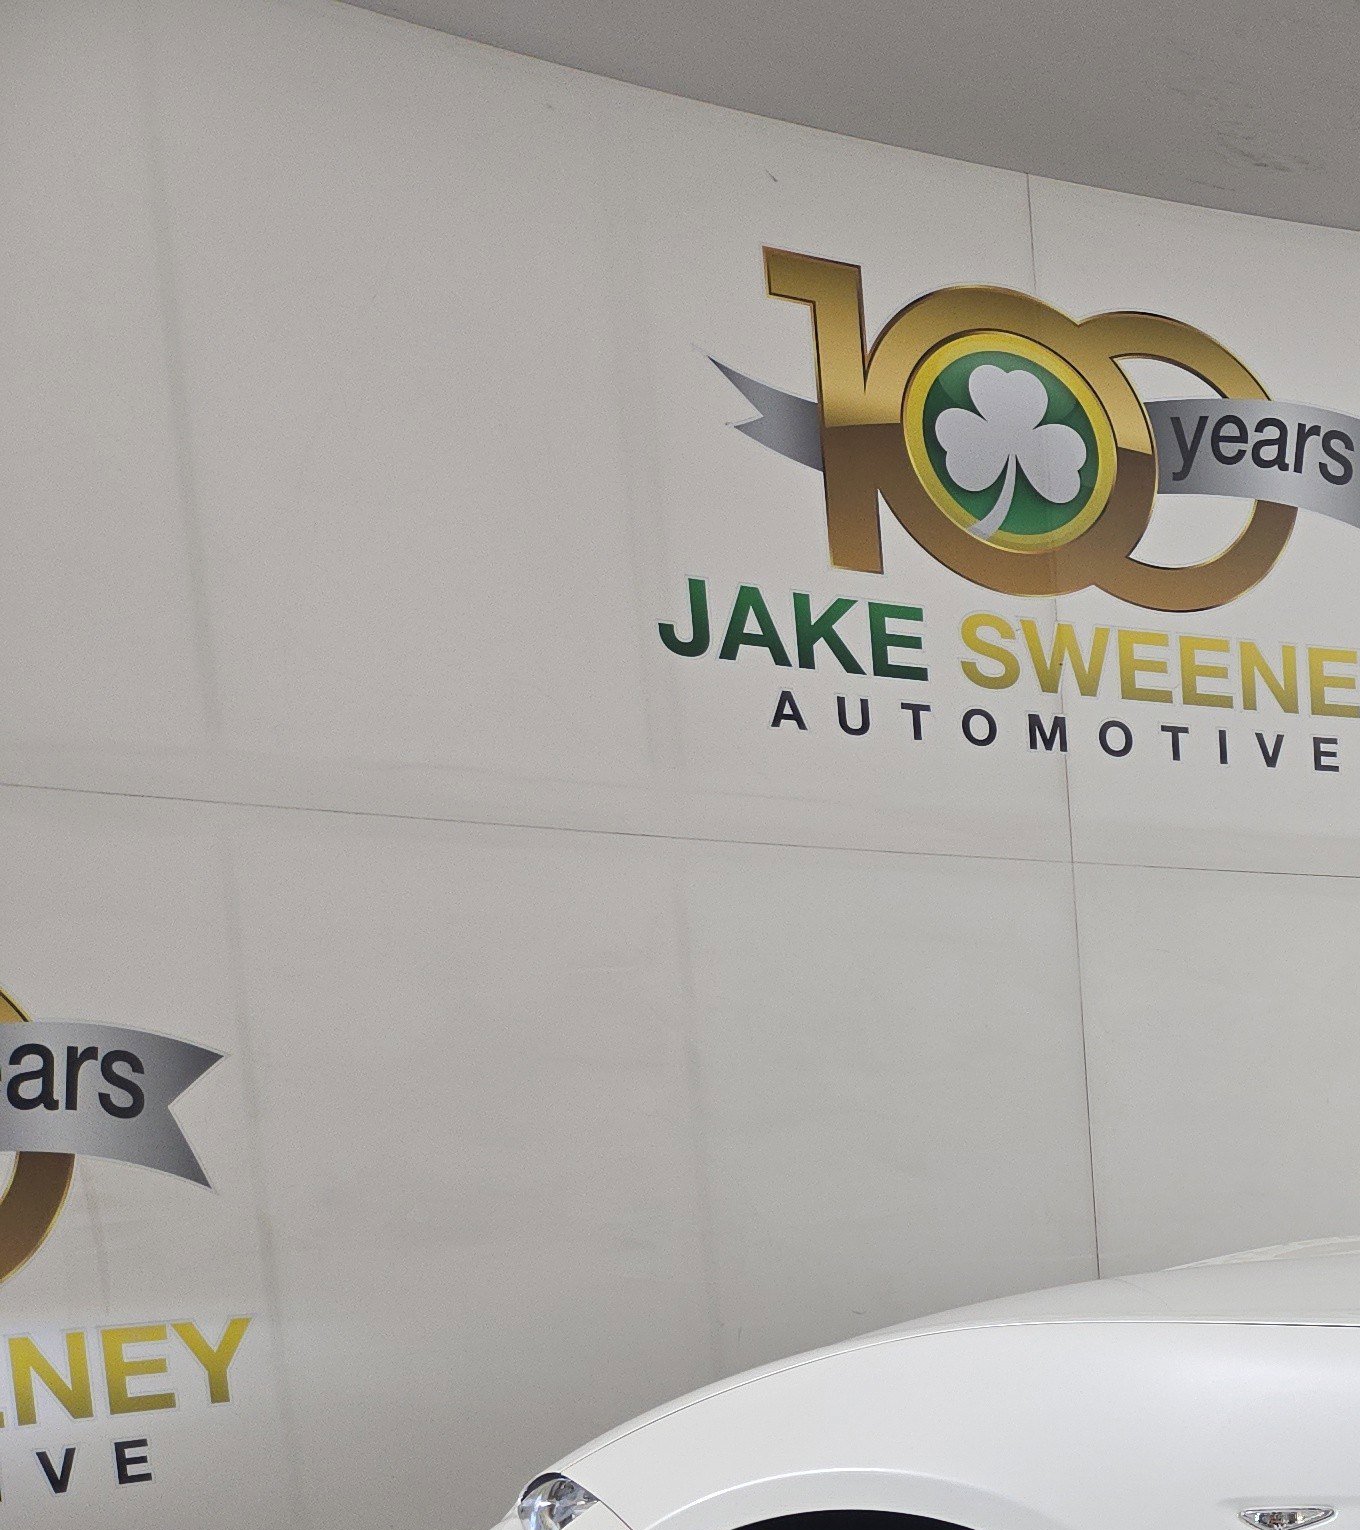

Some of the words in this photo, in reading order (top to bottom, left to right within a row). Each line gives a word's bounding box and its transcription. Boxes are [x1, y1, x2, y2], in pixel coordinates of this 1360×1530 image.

[1169, 412, 1356, 487] years
[657, 577, 929, 683] JAKE
[770, 690, 1341, 773] AUTOMOTIVE
[0, 1041, 146, 1120] ars
[0, 1316, 252, 1428] NEY
